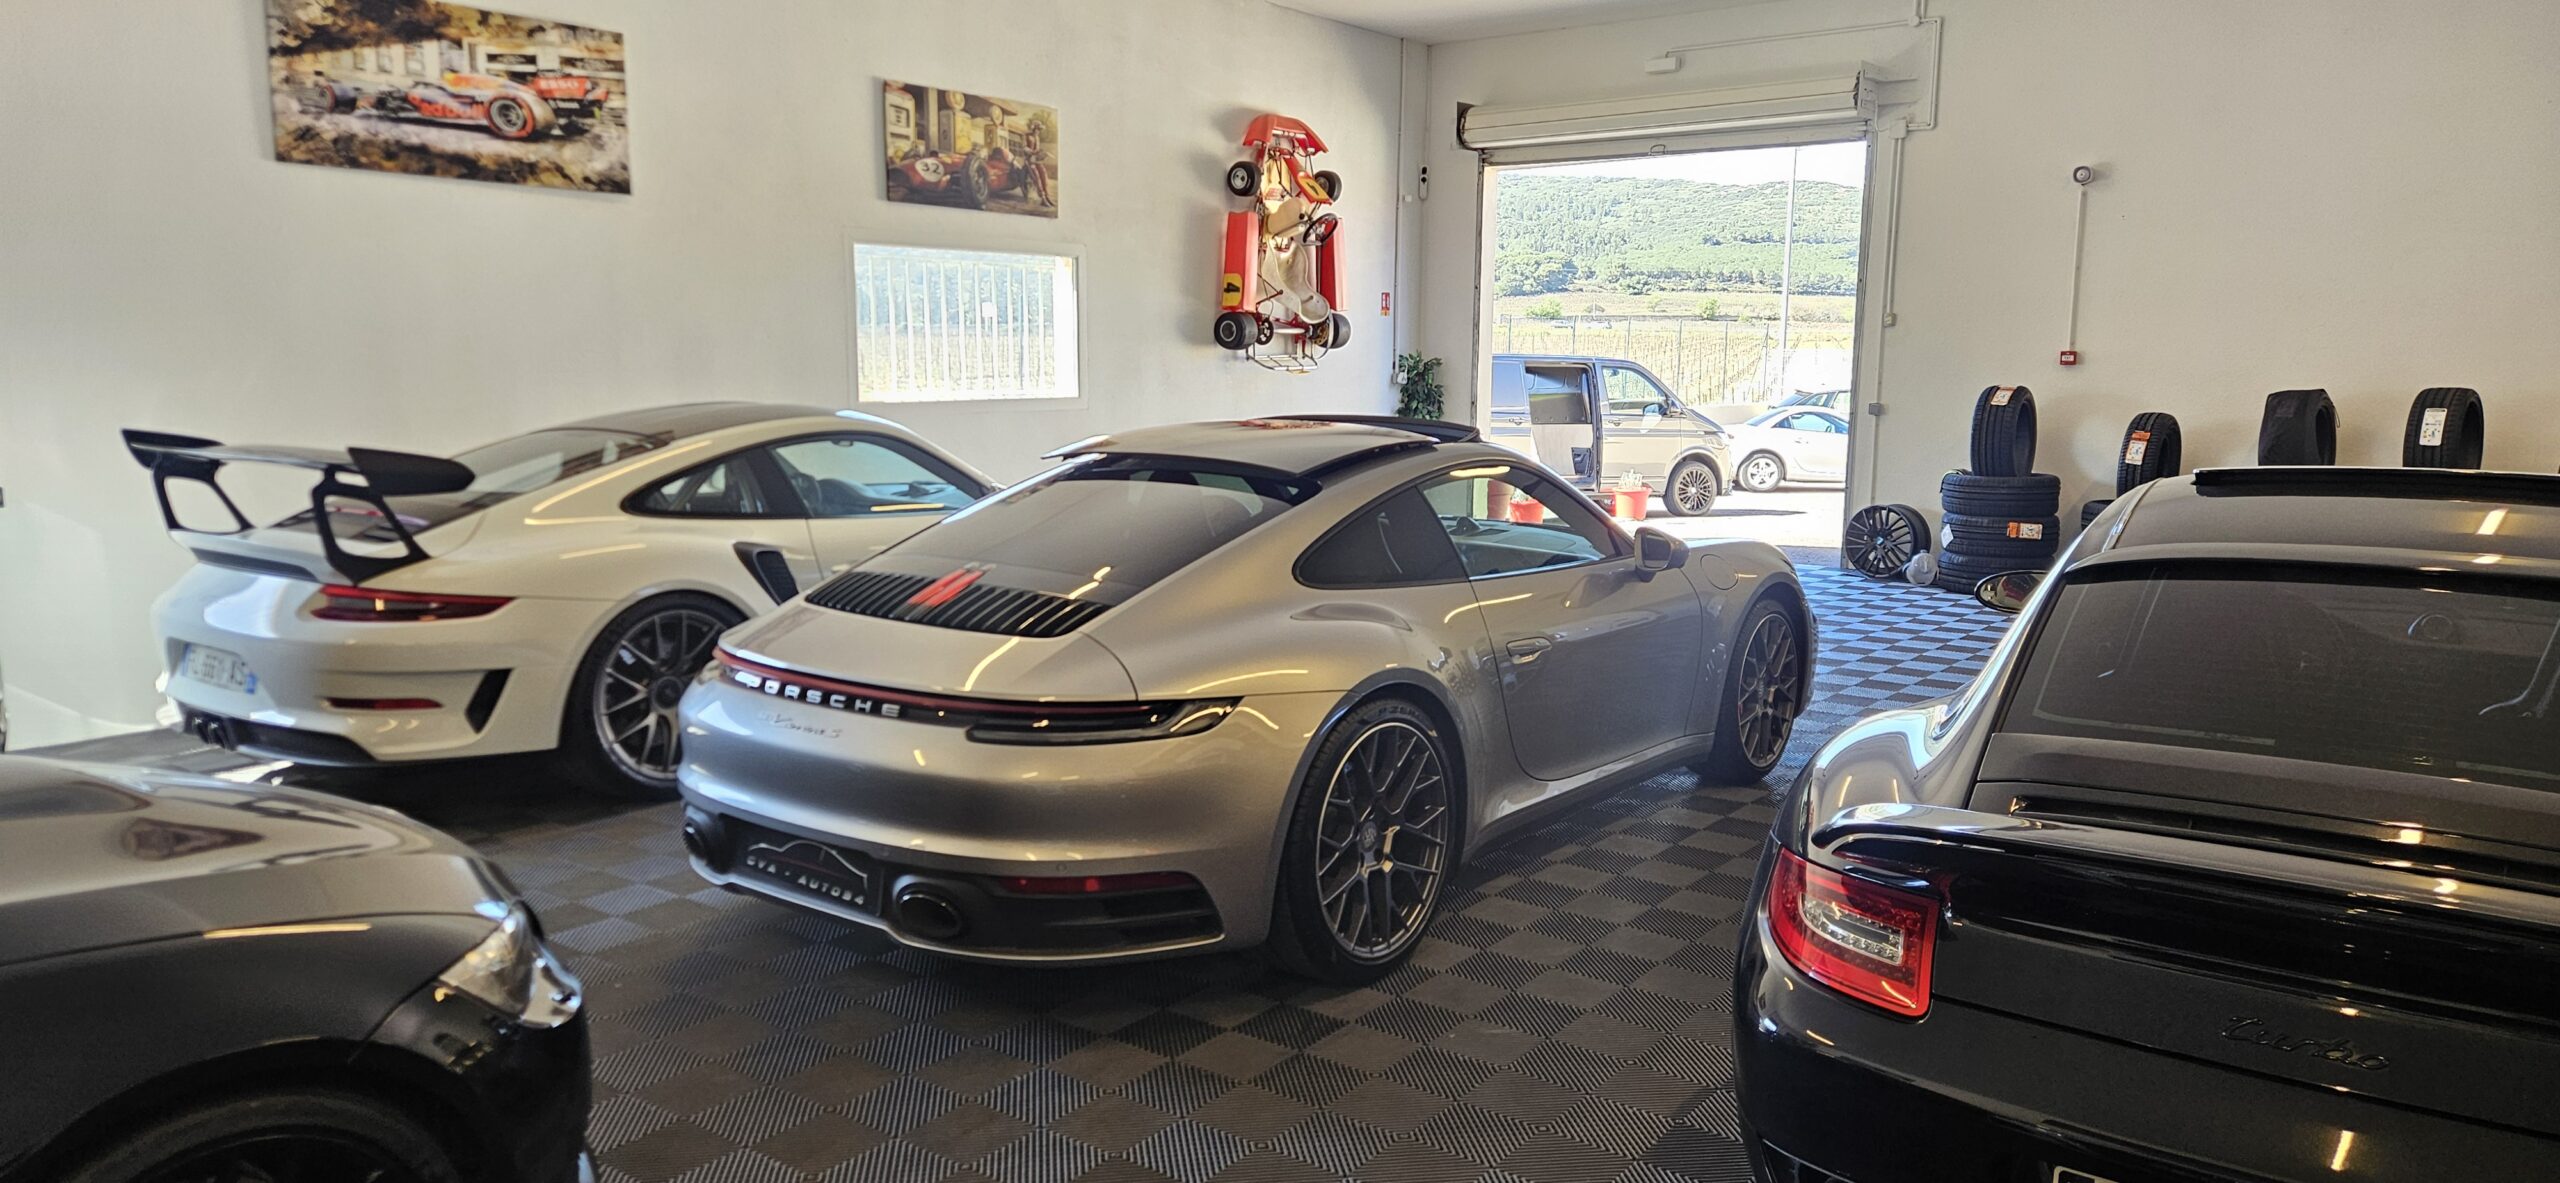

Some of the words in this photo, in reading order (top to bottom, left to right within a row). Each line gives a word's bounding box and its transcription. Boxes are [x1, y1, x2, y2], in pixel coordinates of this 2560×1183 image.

[920, 161, 941, 175] 32
[1223, 281, 1241, 294] 4
[734, 671, 901, 718] PORSCHE
[2221, 1016, 2390, 1071] turbo
